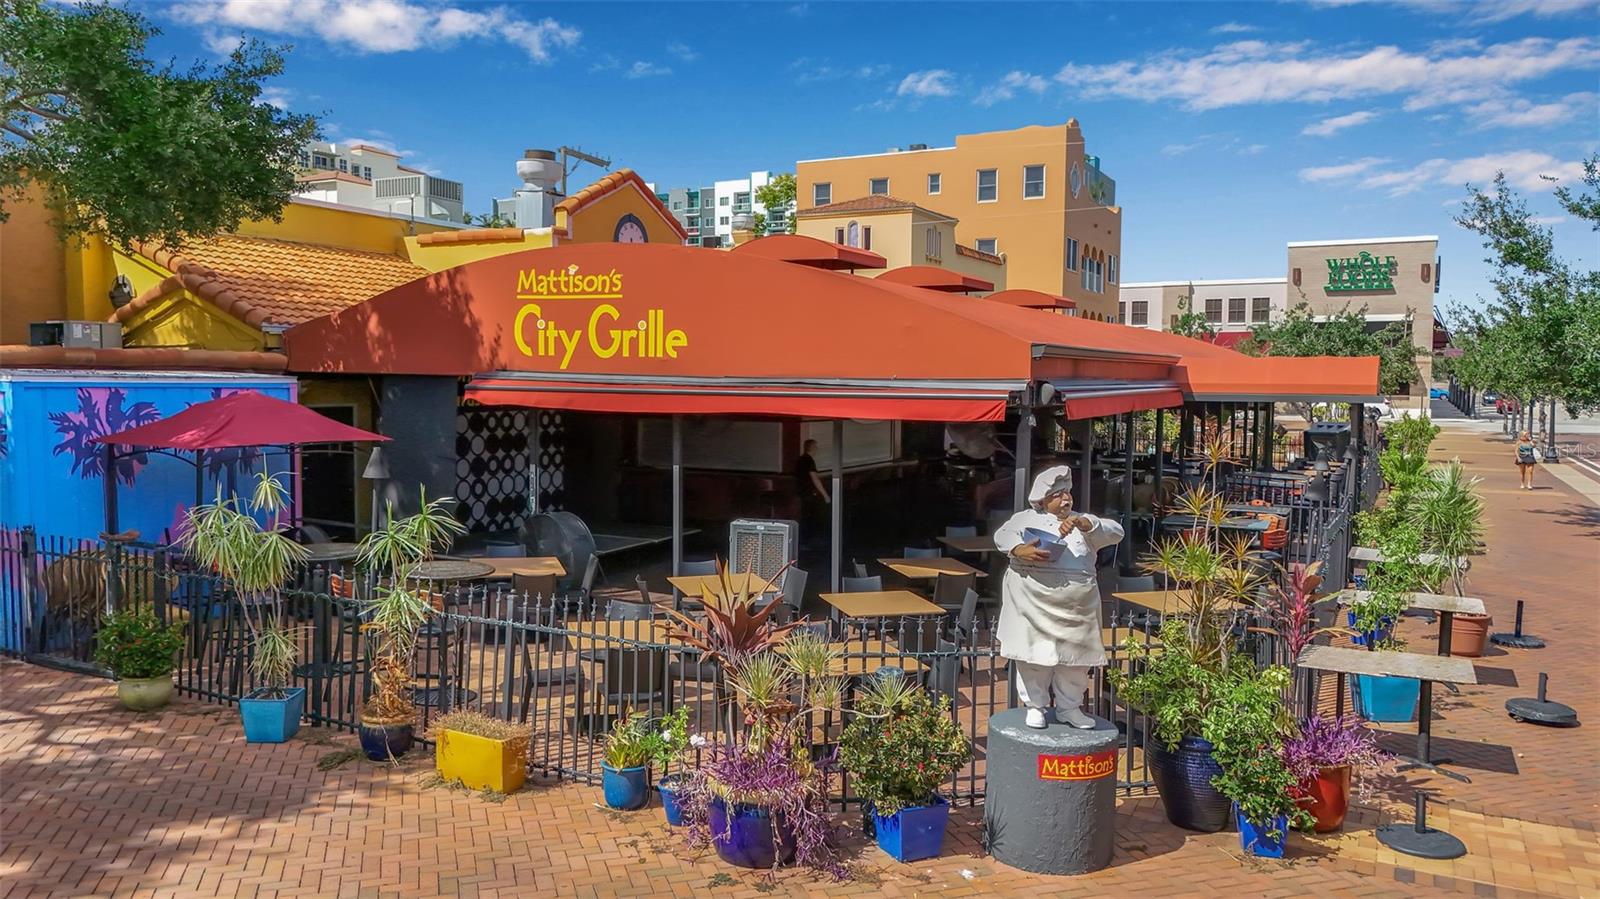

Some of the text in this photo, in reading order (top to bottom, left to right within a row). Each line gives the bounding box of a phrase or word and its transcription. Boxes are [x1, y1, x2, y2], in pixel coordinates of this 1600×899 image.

[1326, 254, 1397, 270] WHOLE
[517, 266, 623, 295] Mattison's
[1328, 270, 1391, 284] FOODS
[514, 303, 688, 369] City Grille
[1042, 755, 1113, 776] Mattison's
